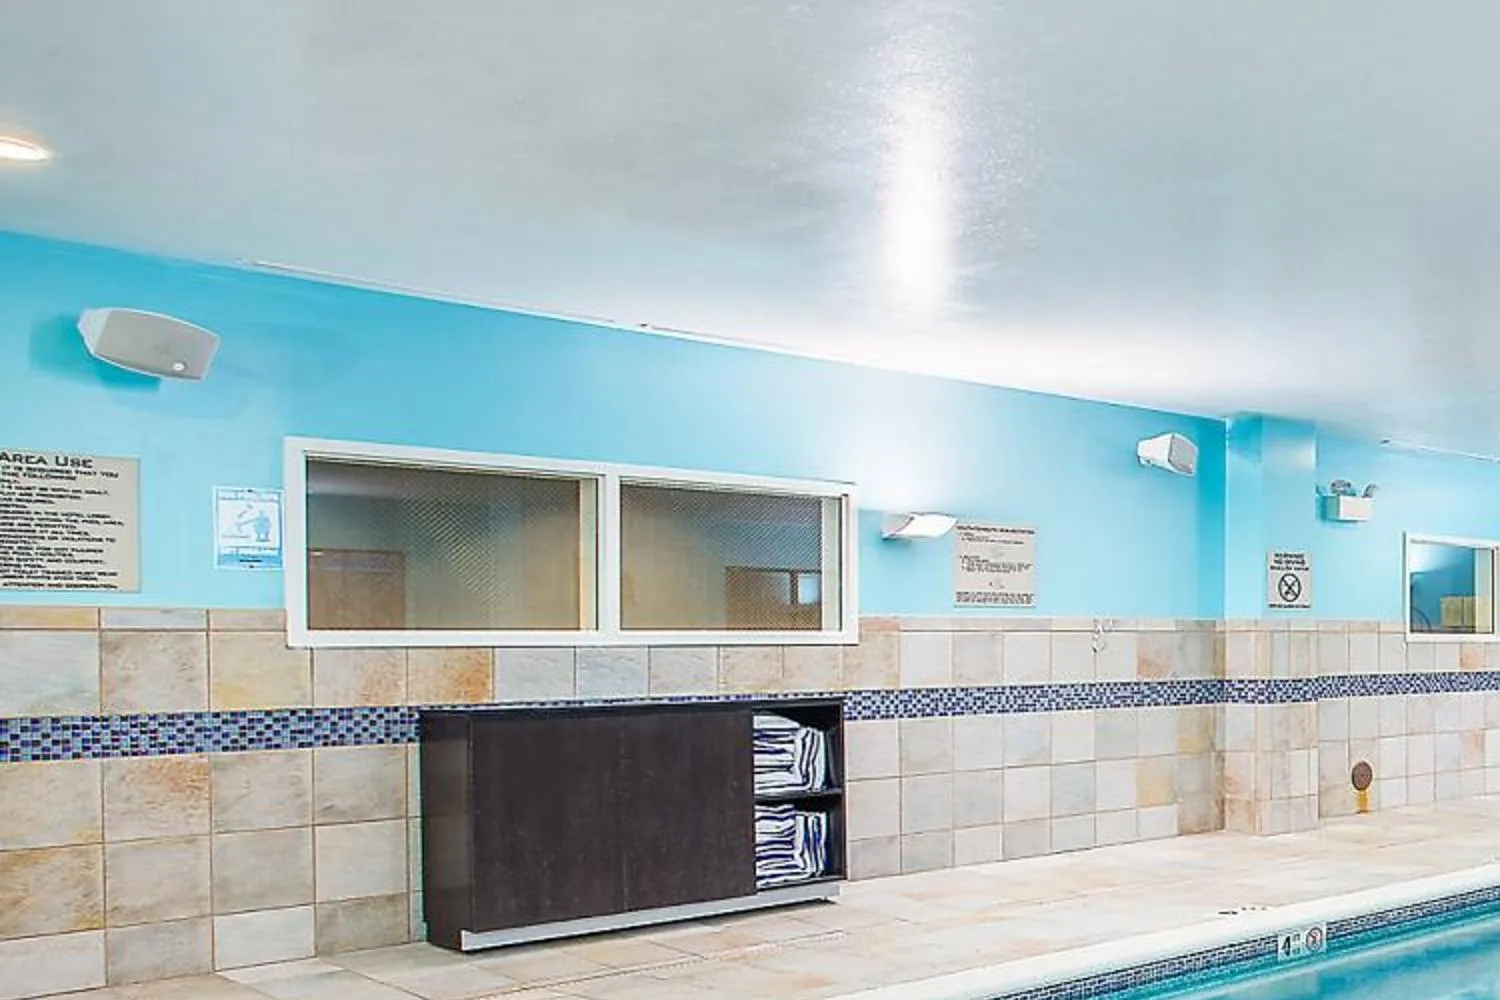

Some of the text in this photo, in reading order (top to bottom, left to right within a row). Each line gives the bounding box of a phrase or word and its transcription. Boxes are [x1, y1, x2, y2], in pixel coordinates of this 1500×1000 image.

[0, 451, 93, 469] AREA USE
[1282, 936, 1291, 957] 4
